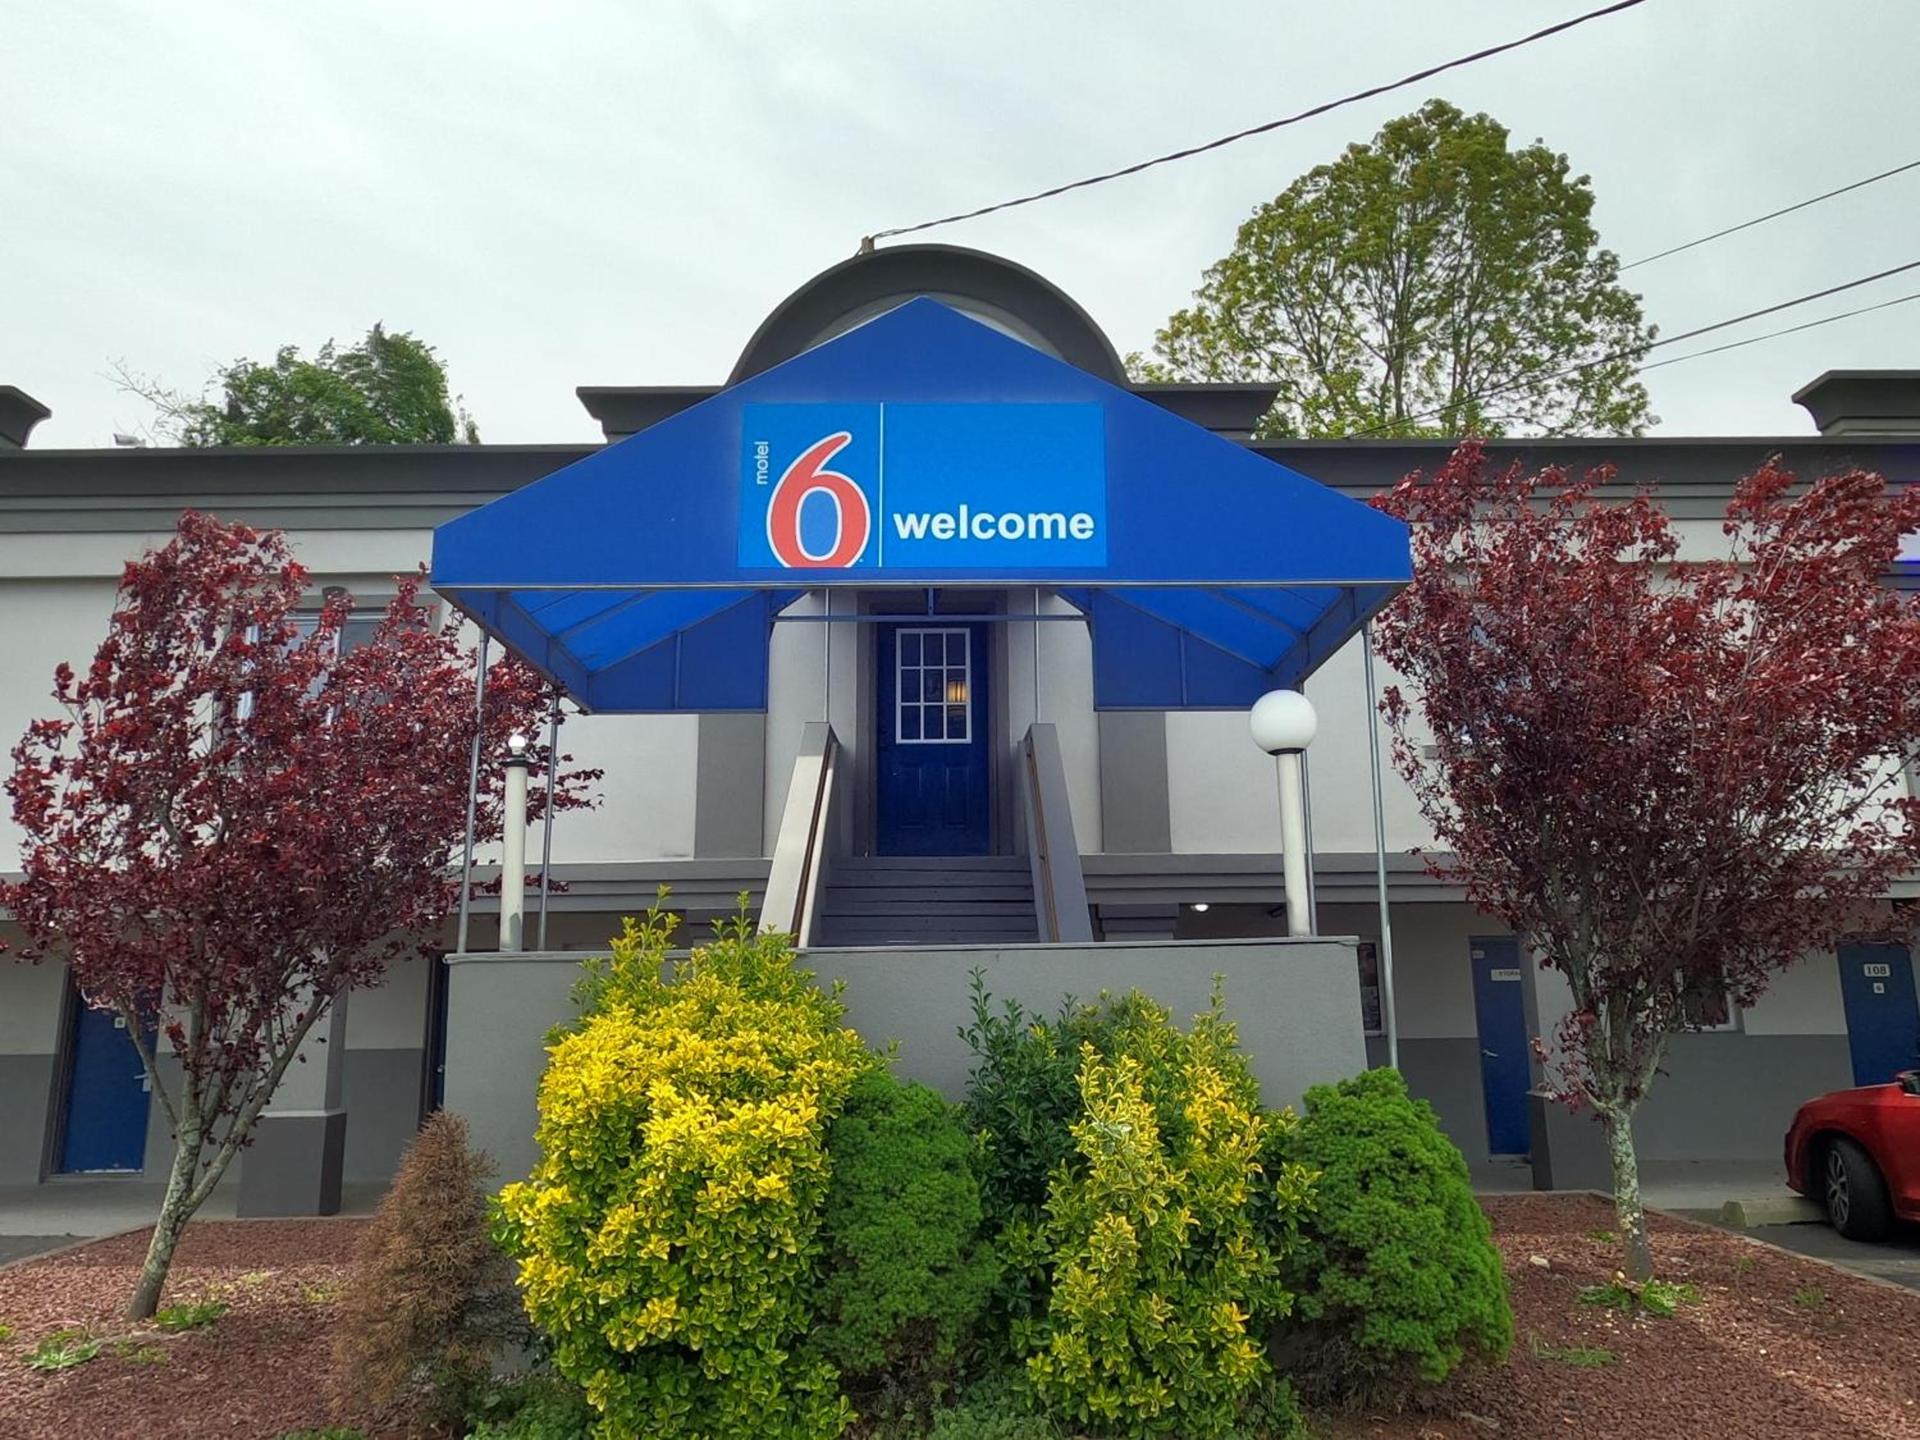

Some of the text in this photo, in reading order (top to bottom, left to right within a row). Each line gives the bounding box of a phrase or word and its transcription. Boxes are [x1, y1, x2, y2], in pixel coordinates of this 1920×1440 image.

[754, 441, 769, 485] motel
[766, 431, 871, 568] 6
[893, 504, 1095, 540] welcome
[1865, 965, 1888, 976] 108
